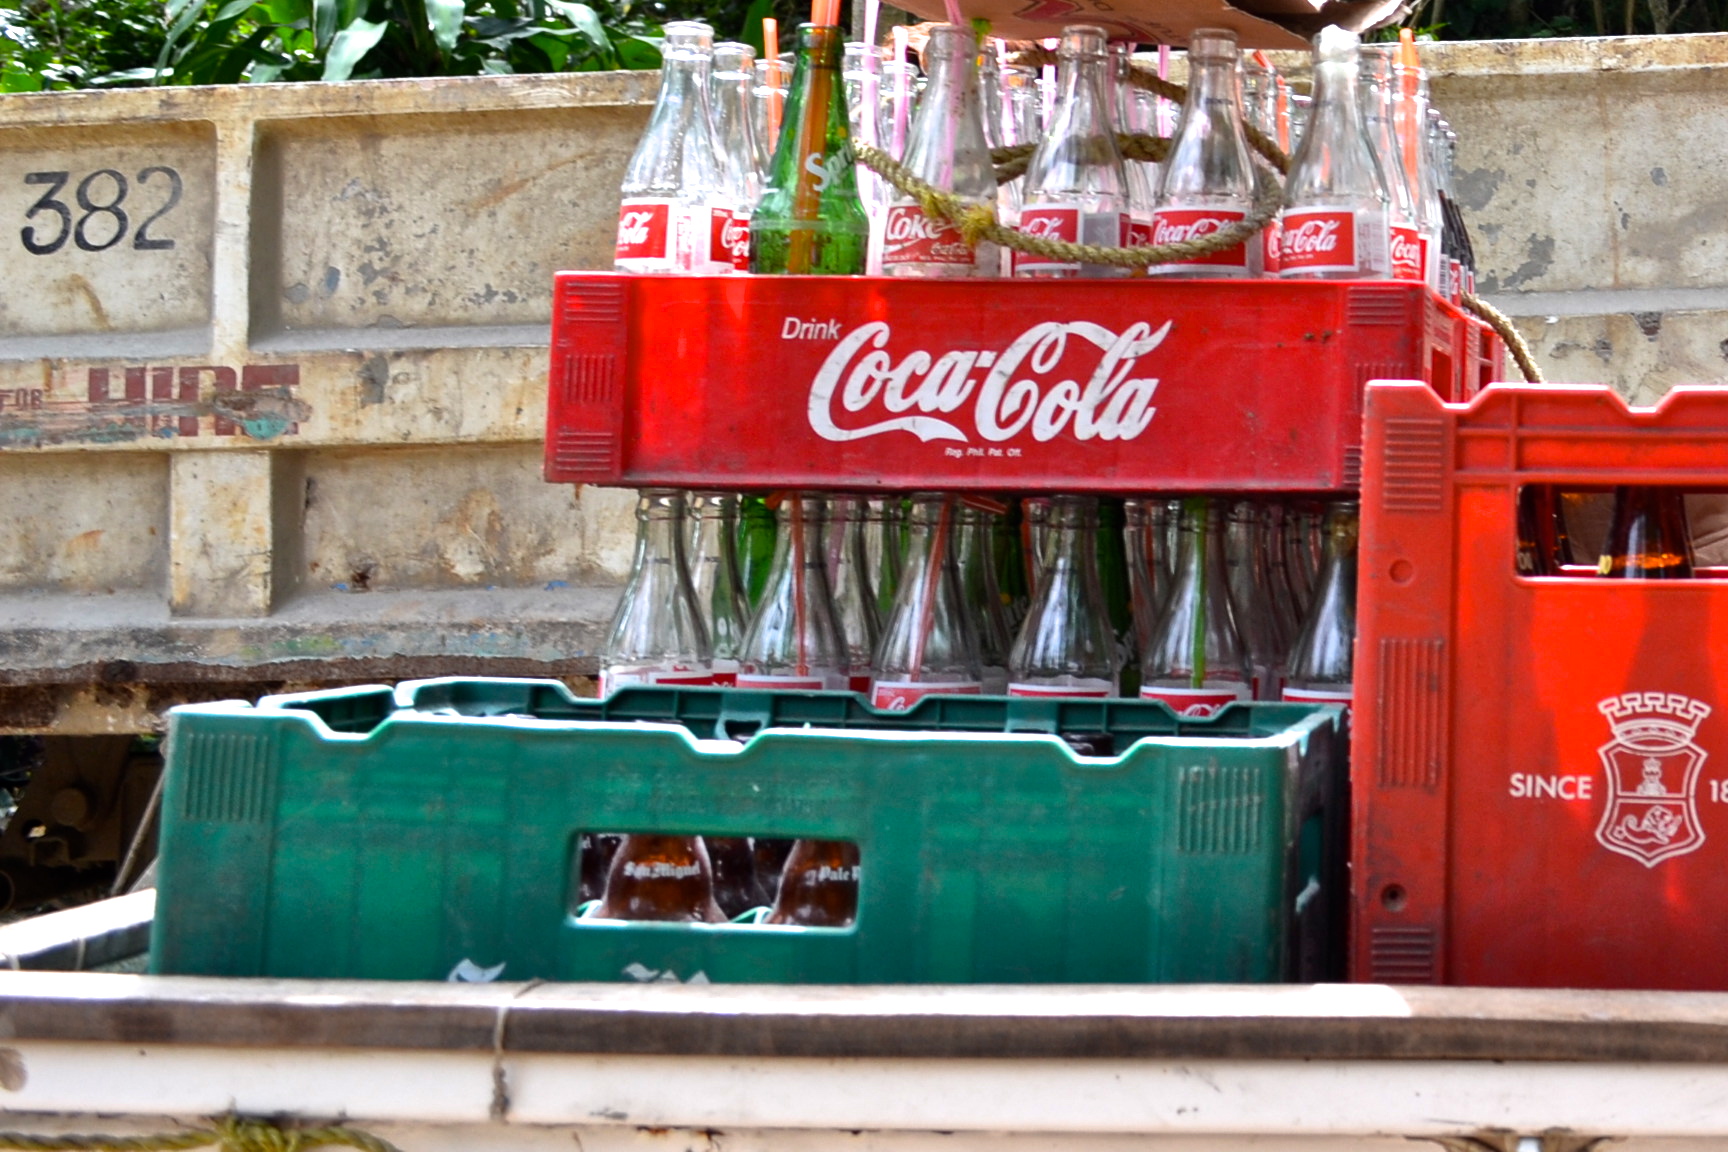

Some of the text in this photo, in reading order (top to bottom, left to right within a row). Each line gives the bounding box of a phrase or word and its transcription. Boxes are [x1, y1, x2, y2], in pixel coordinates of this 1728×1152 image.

[21, 166, 183, 255] 382
[781, 316, 1172, 442] Drink Coca-Cola
[1509, 773, 1592, 799] SINCE
